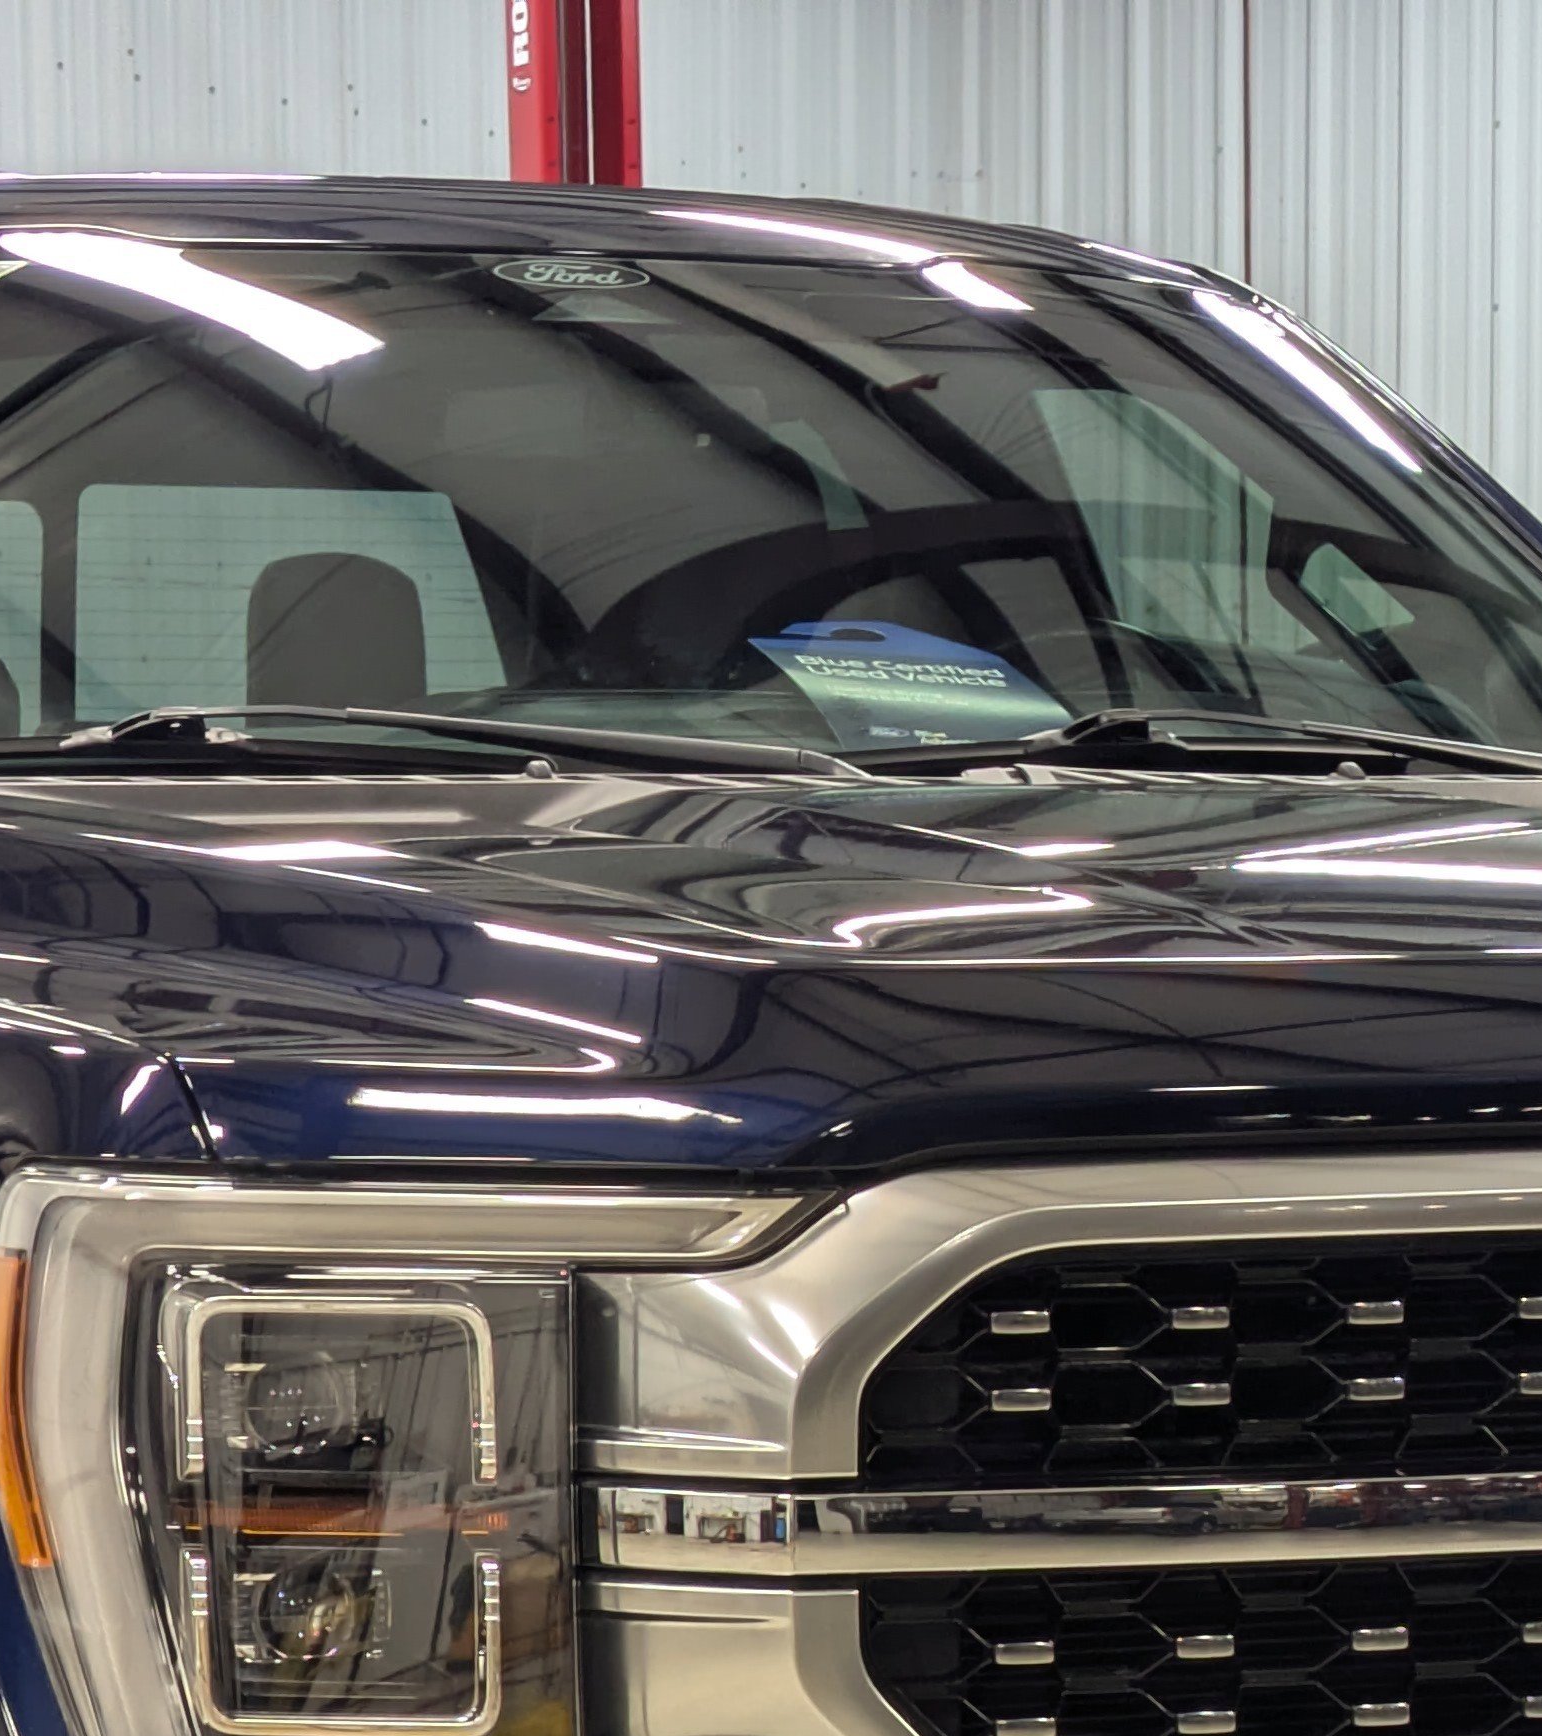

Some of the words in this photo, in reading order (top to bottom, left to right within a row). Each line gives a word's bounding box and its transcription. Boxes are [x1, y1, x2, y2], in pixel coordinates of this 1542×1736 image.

[523, 262, 624, 286] Ford
[793, 653, 868, 670] Blue
[871, 659, 1006, 679] Certified
[805, 664, 890, 681] Used
[891, 669, 1008, 688] Vehicle
